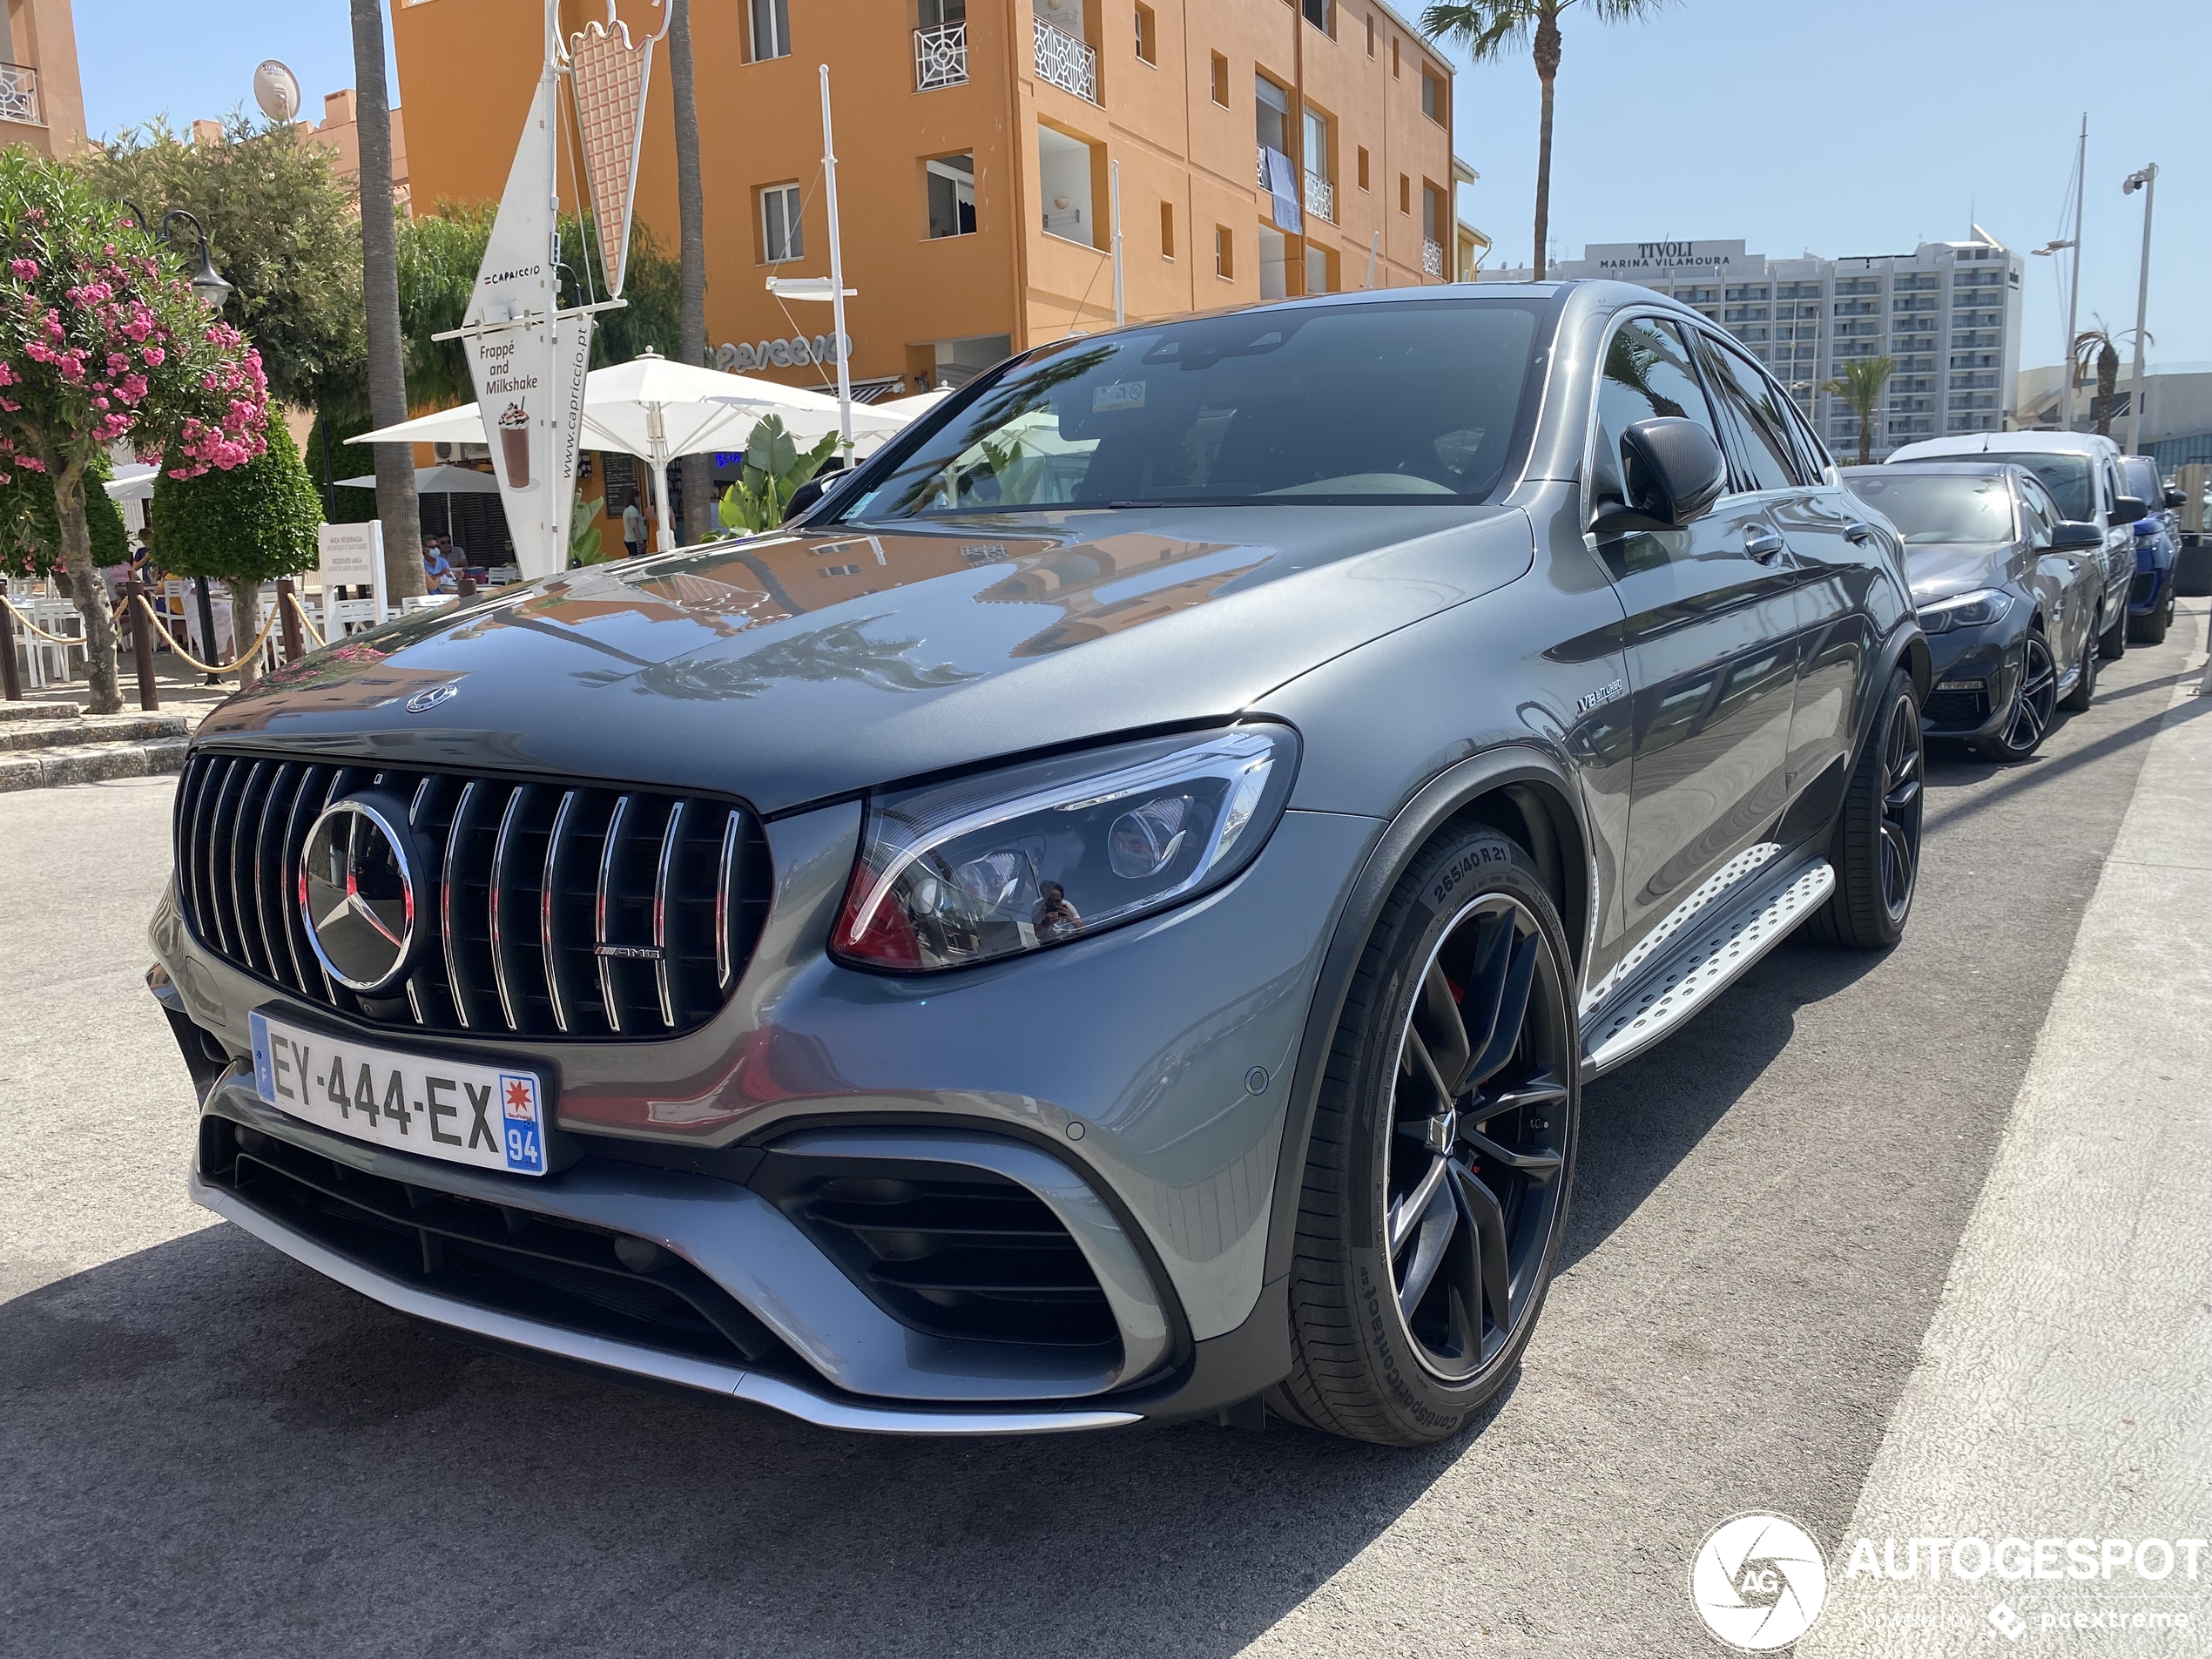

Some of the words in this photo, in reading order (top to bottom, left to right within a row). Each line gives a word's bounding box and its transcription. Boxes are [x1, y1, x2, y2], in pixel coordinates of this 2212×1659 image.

[1638, 242, 1693, 259] TIVOLI
[1600, 259, 1649, 268] MARINA
[1656, 256, 1730, 266] VILAMOURA
[491, 265, 540, 284] CAPRICCIO
[480, 340, 515, 360] Frappé
[715, 331, 853, 374] PRICCIO
[489, 360, 509, 376] and
[486, 374, 537, 395] Milkshake
[563, 327, 588, 479] www.capriccio.pt
[1433, 852, 1480, 905] 265/40
[1480, 847, 1492, 863] R
[1493, 846, 1507, 861] 21
[614, 948, 660, 959] AMG
[261, 1067, 267, 1084] F
[271, 1033, 500, 1154] EY-444-EX
[508, 1129, 538, 1163] 94
